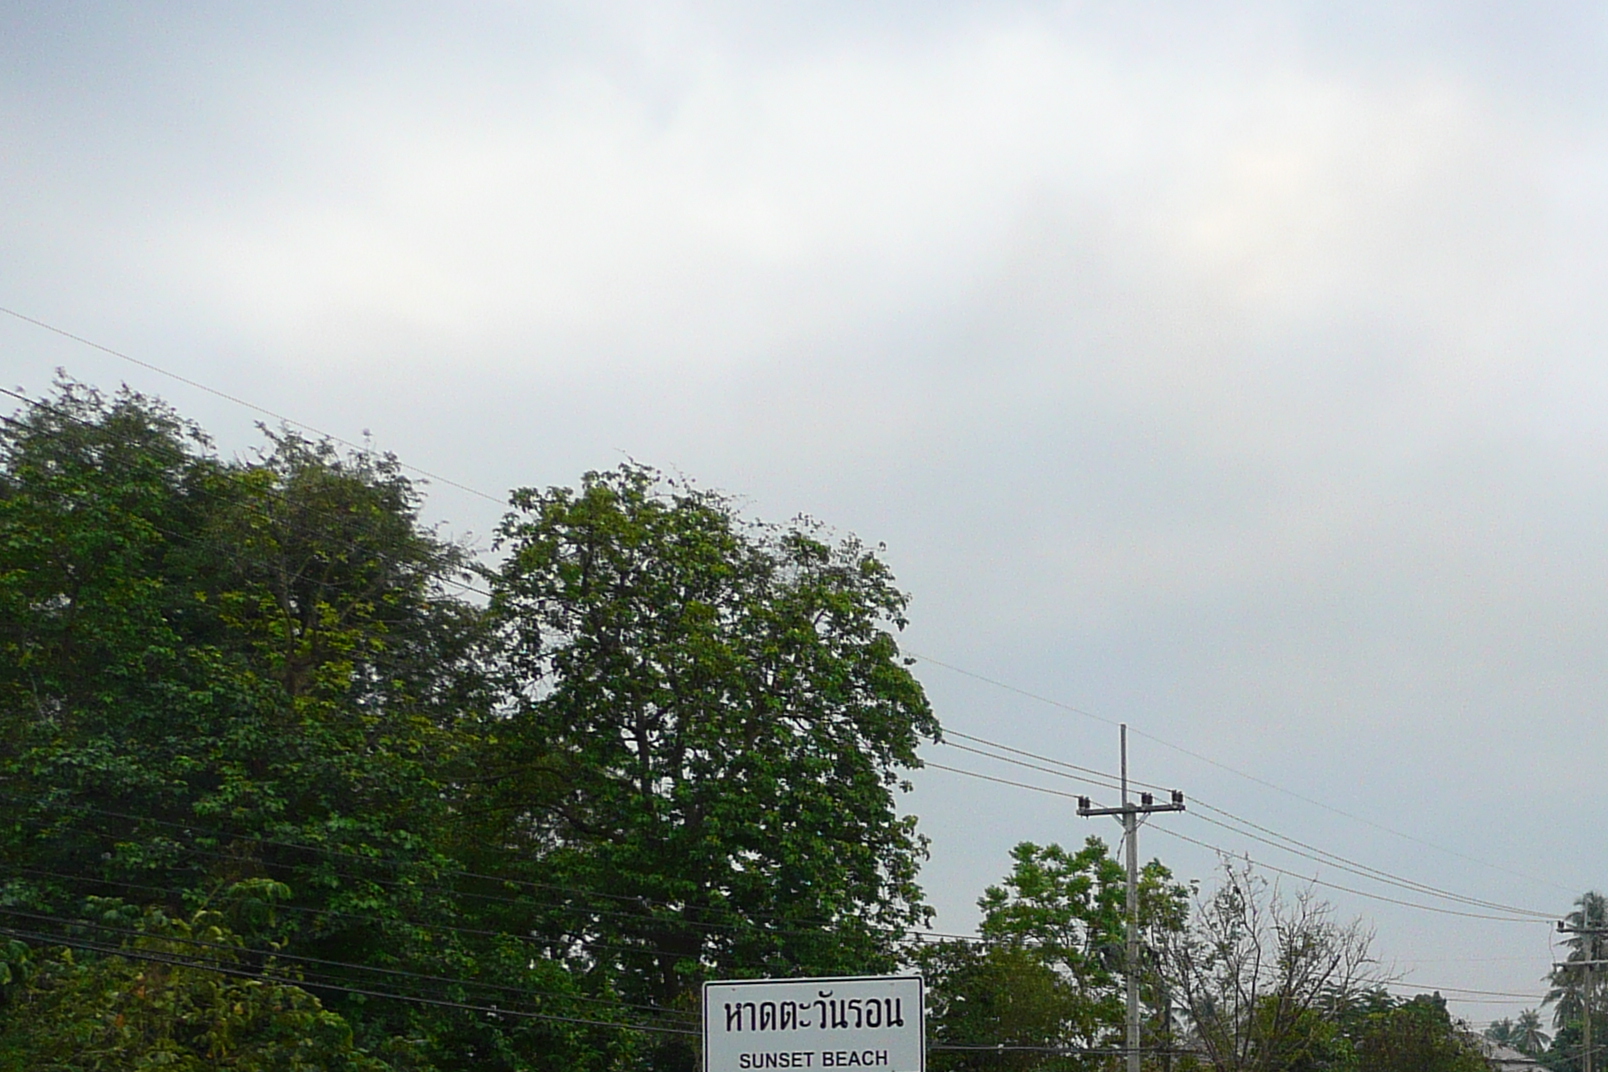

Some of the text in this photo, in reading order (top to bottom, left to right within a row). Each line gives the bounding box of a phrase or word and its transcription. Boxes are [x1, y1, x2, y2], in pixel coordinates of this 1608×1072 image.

[724, 990, 905, 1032] หาดตะวันรอน
[739, 1050, 888, 1070] SUNSET BEACH
